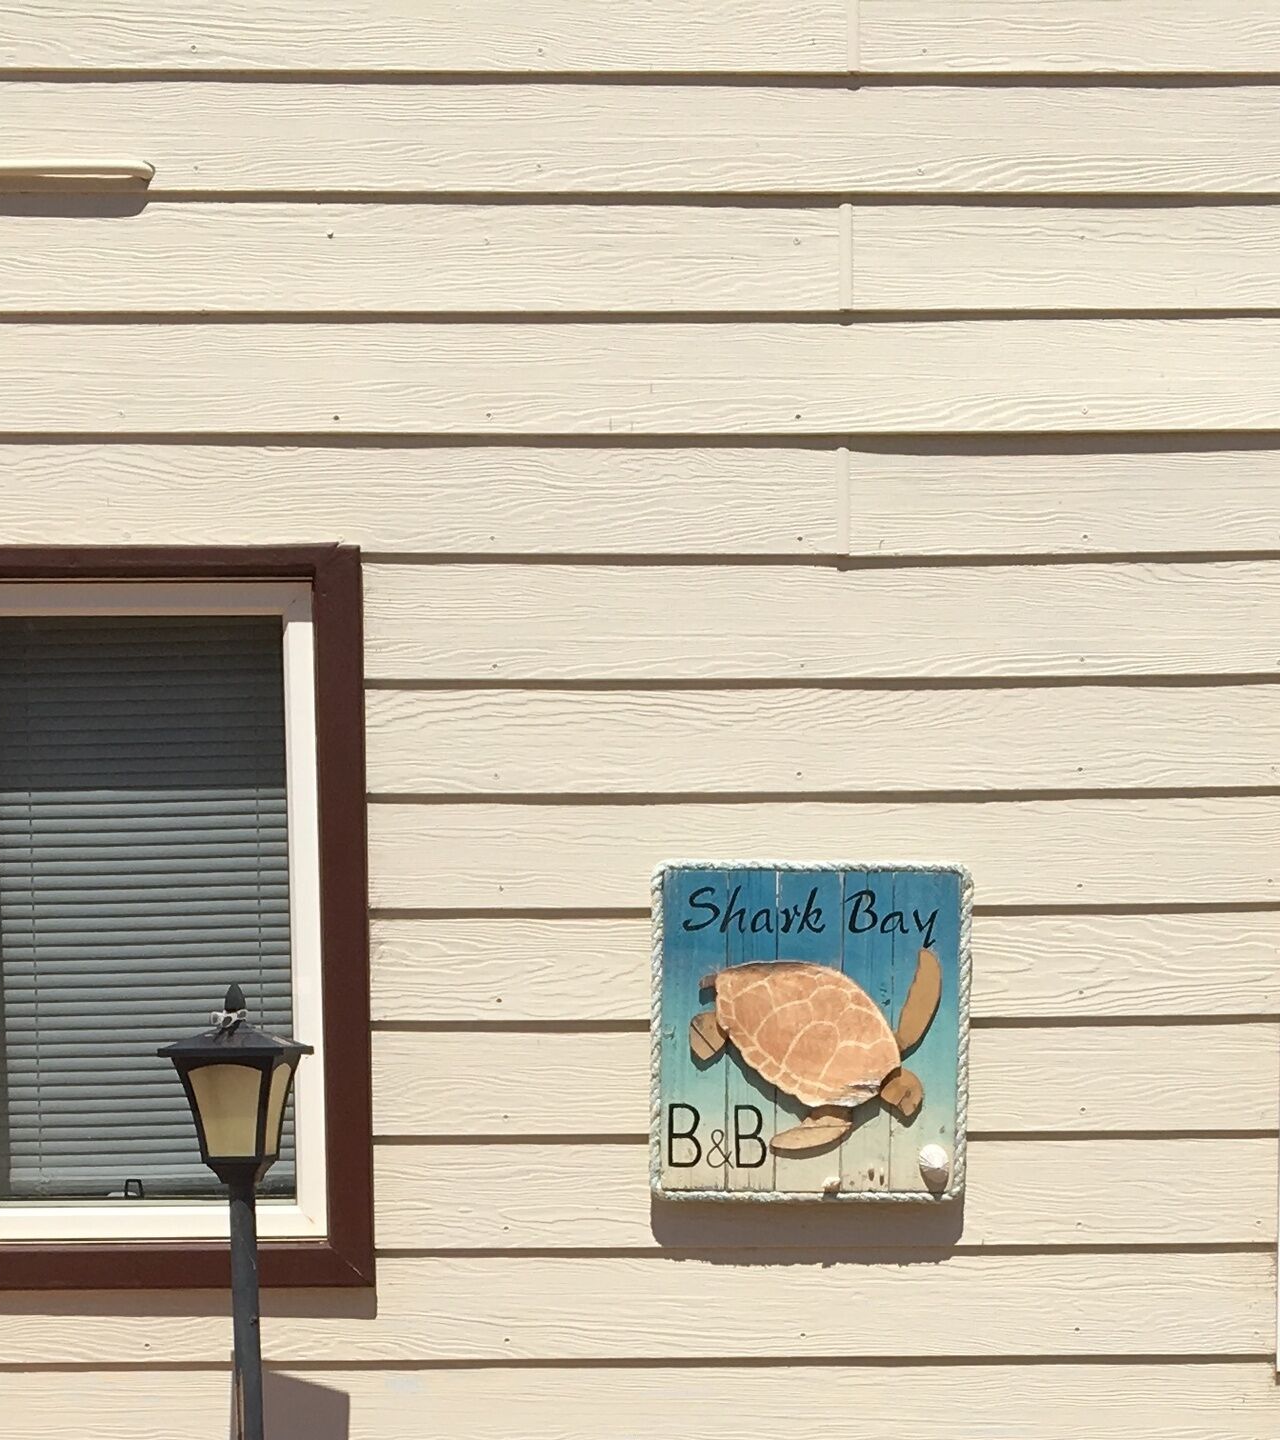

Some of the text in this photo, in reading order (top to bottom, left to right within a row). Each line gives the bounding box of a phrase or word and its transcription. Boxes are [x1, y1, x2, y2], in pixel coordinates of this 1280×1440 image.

[682, 885, 939, 949] Shark Bay
[667, 1102, 768, 1170] B&B
